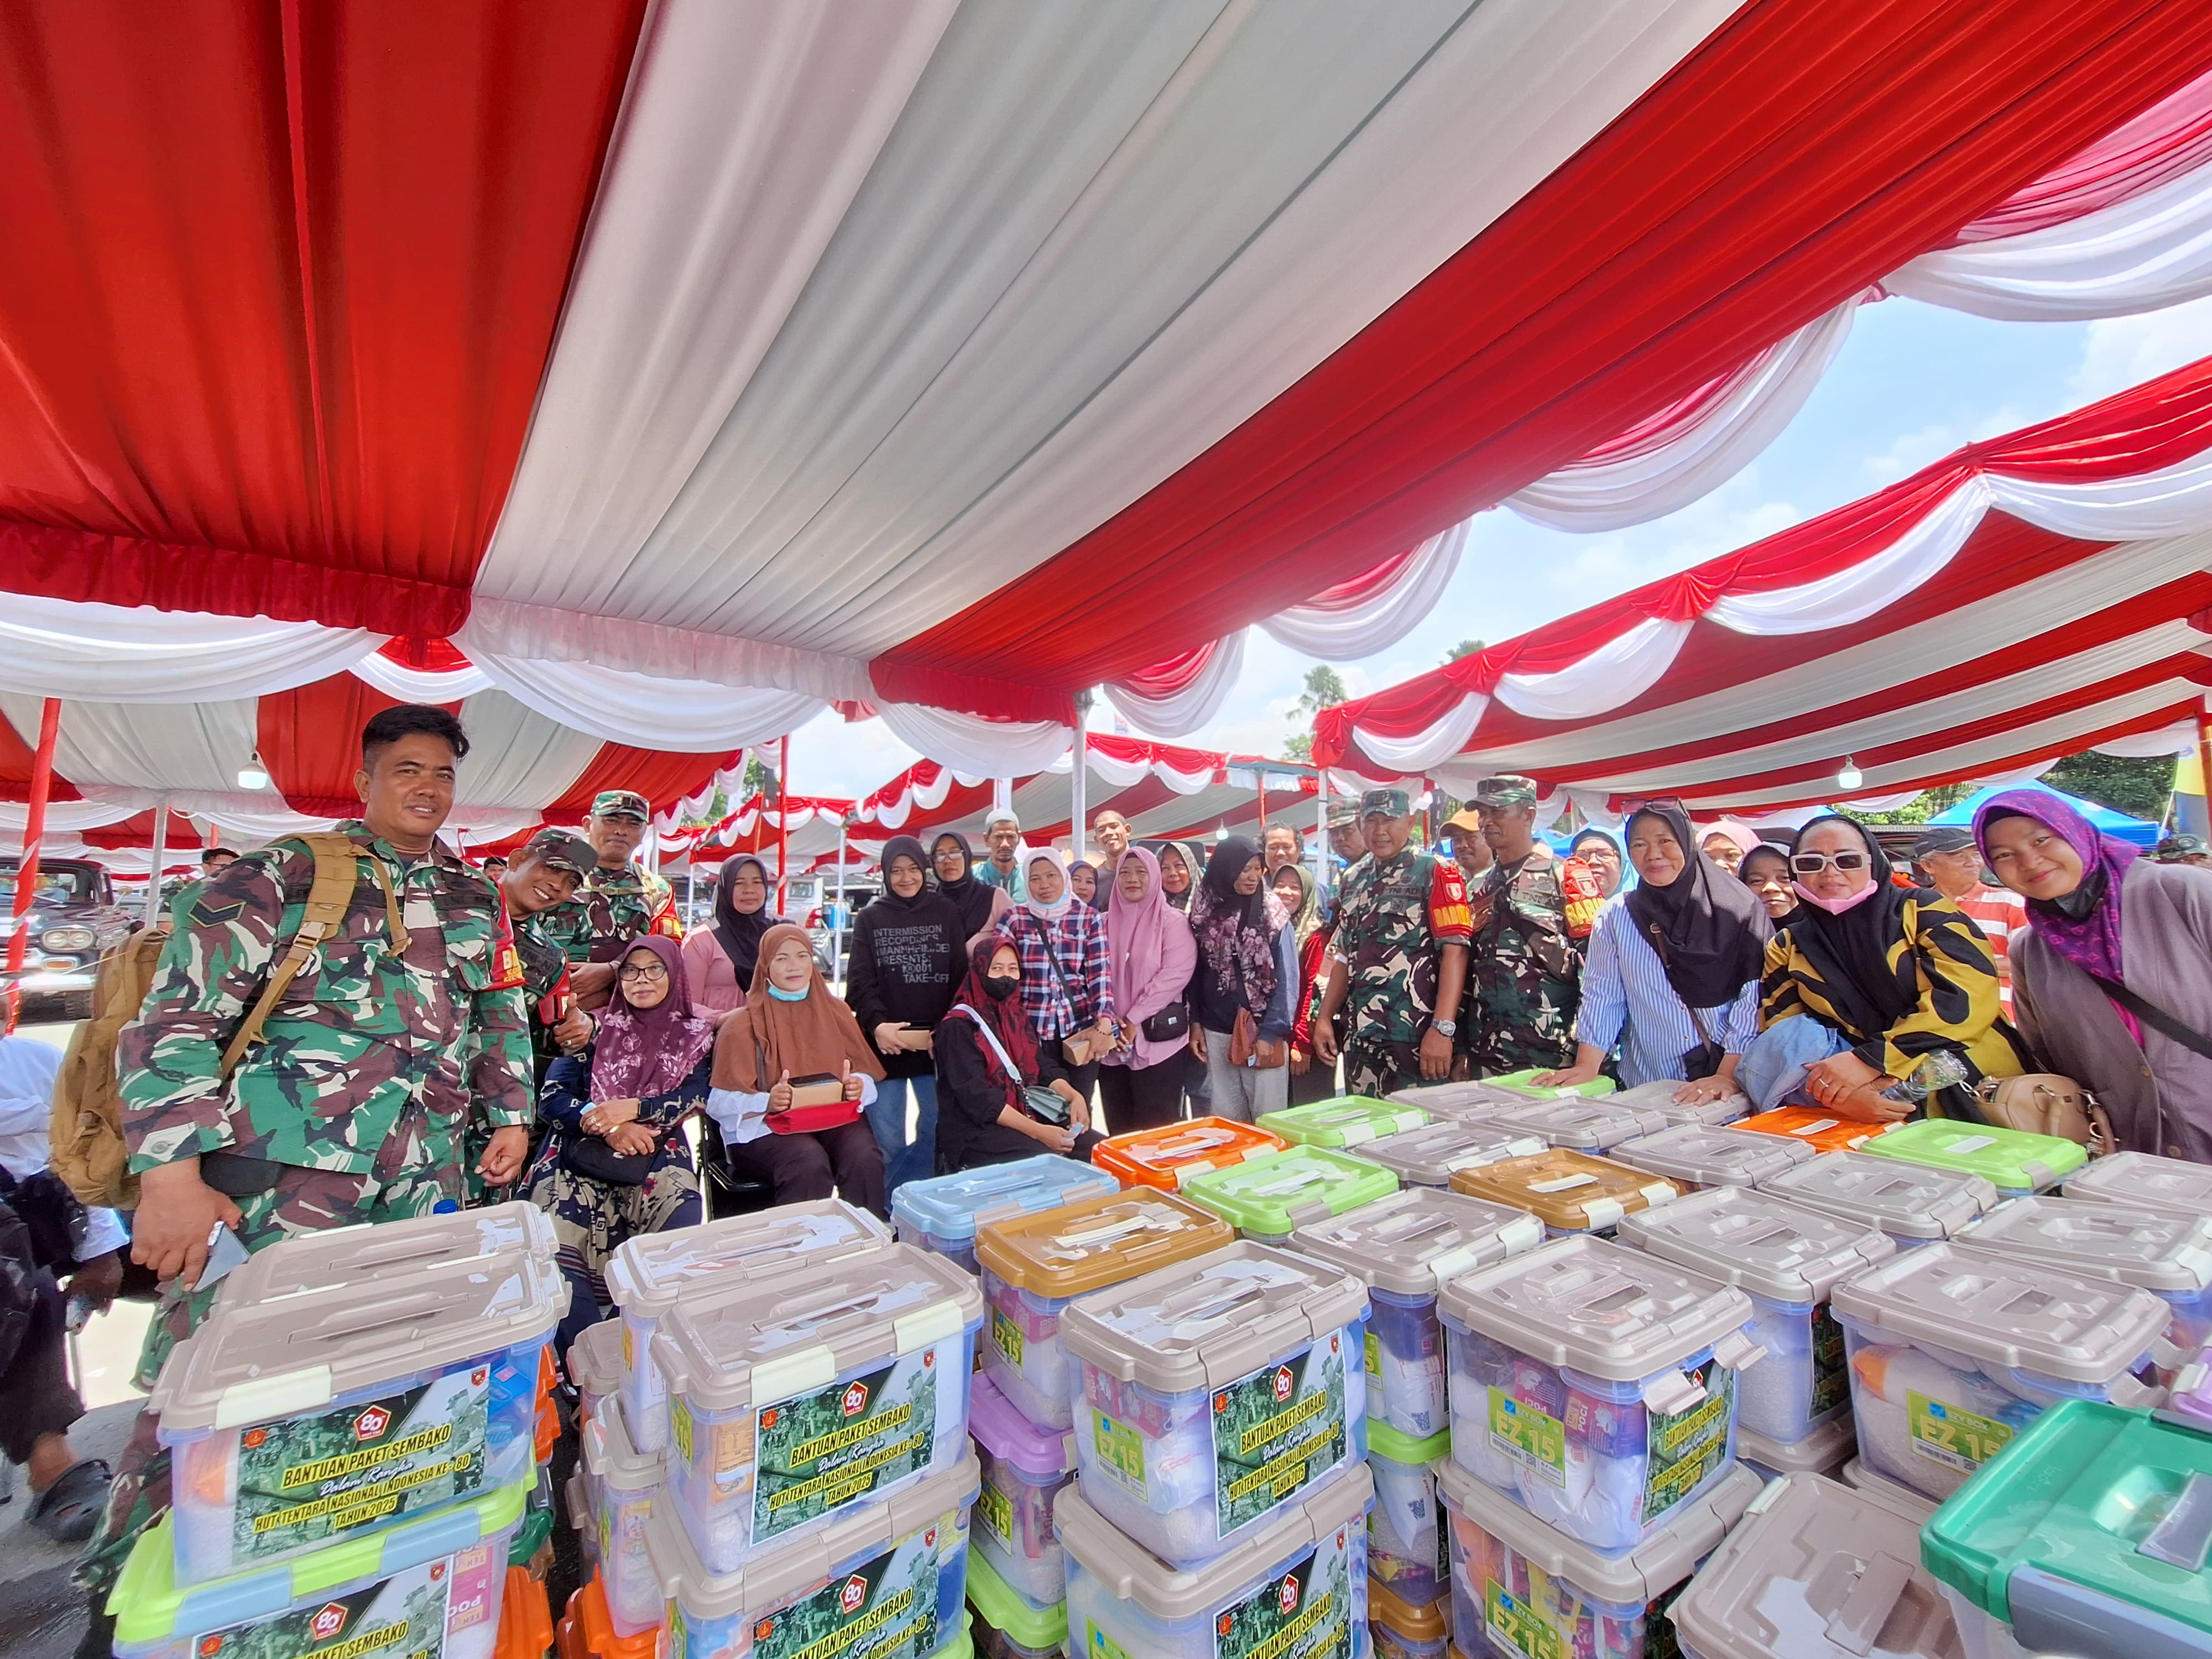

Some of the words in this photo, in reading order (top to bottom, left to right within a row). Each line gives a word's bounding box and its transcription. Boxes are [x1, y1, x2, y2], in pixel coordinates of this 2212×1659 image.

[873, 924, 942, 938] INTERMISSION
[1008, 1336, 1019, 1361] 15
[846, 1390, 863, 1407] 80
[1277, 1374, 1290, 1391] 80
[360, 1413, 383, 1432] 80
[791, 1434, 839, 1466] BANTUAN
[839, 1422, 867, 1446] PAKET
[868, 1403, 911, 1434] SEMBAKO
[1241, 1420, 1276, 1453] BANTUAN
[1276, 1408, 1296, 1433] PAKET
[1297, 1390, 1327, 1422] SEMBAKO
[1577, 1404, 1589, 1433] POCI
[1919, 1413, 1958, 1452] EZ
[818, 1452, 848, 1473] Dalam
[851, 1434, 885, 1459] Rangka
[1262, 1439, 1285, 1461] Dalam
[1287, 1425, 1311, 1449] Rangka
[1496, 1410, 1522, 1447] EZ
[1528, 1429, 1556, 1463] 15
[283, 1457, 348, 1488] BANTUAN
[348, 1445, 389, 1472] PAKET
[390, 1425, 451, 1458] SEMBAKO
[769, 1494, 787, 1510] HUT
[789, 1478, 822, 1501] TENTARA
[824, 1462, 861, 1489] NASIONAL
[862, 1448, 898, 1472] INDONESIA
[913, 1432, 924, 1448] 80
[1098, 1431, 1118, 1465] EZ
[1120, 1445, 1140, 1478] 15
[1229, 1484, 1243, 1501] HUT
[1244, 1466, 1268, 1491] TENTARA
[1270, 1451, 1296, 1478] NASIONAL
[1296, 1435, 1322, 1462] INDONESIA
[254, 1515, 278, 1532] HUT
[281, 1501, 327, 1524] TENTARA
[329, 1484, 381, 1510] NASIONAL
[383, 1467, 434, 1493] INDONESIA
[455, 1454, 471, 1470] 80
[320, 1475, 363, 1496] Dalam
[367, 1459, 414, 1483] Rangka
[827, 1483, 853, 1504] TAHUN
[852, 1474, 872, 1493] 2025
[1274, 1475, 1291, 1497] TAHUN
[1291, 1463, 1305, 1485] 2025
[335, 1505, 369, 1528] TAHUN
[369, 1497, 397, 1516] 2025
[995, 1507, 1008, 1536] 15
[448, 1594, 482, 1618] POC
[844, 1584, 862, 1603] 80
[1282, 1584, 1295, 1603] 80
[316, 1610, 340, 1630] 80
[791, 1634, 838, 1659] NTUAN
[838, 1617, 868, 1646] PAKET
[868, 1588, 912, 1627] SEMBAKO
[915, 1614, 927, 1632] 80
[1246, 1634, 1280, 1659] NTUAN
[1280, 1617, 1302, 1648] PAKET
[1302, 1592, 1332, 1633] SEMBAKO
[1493, 1601, 1519, 1646] EZ
[346, 1621, 409, 1657] SEMBAKO
[852, 1627, 887, 1657] Rangka
